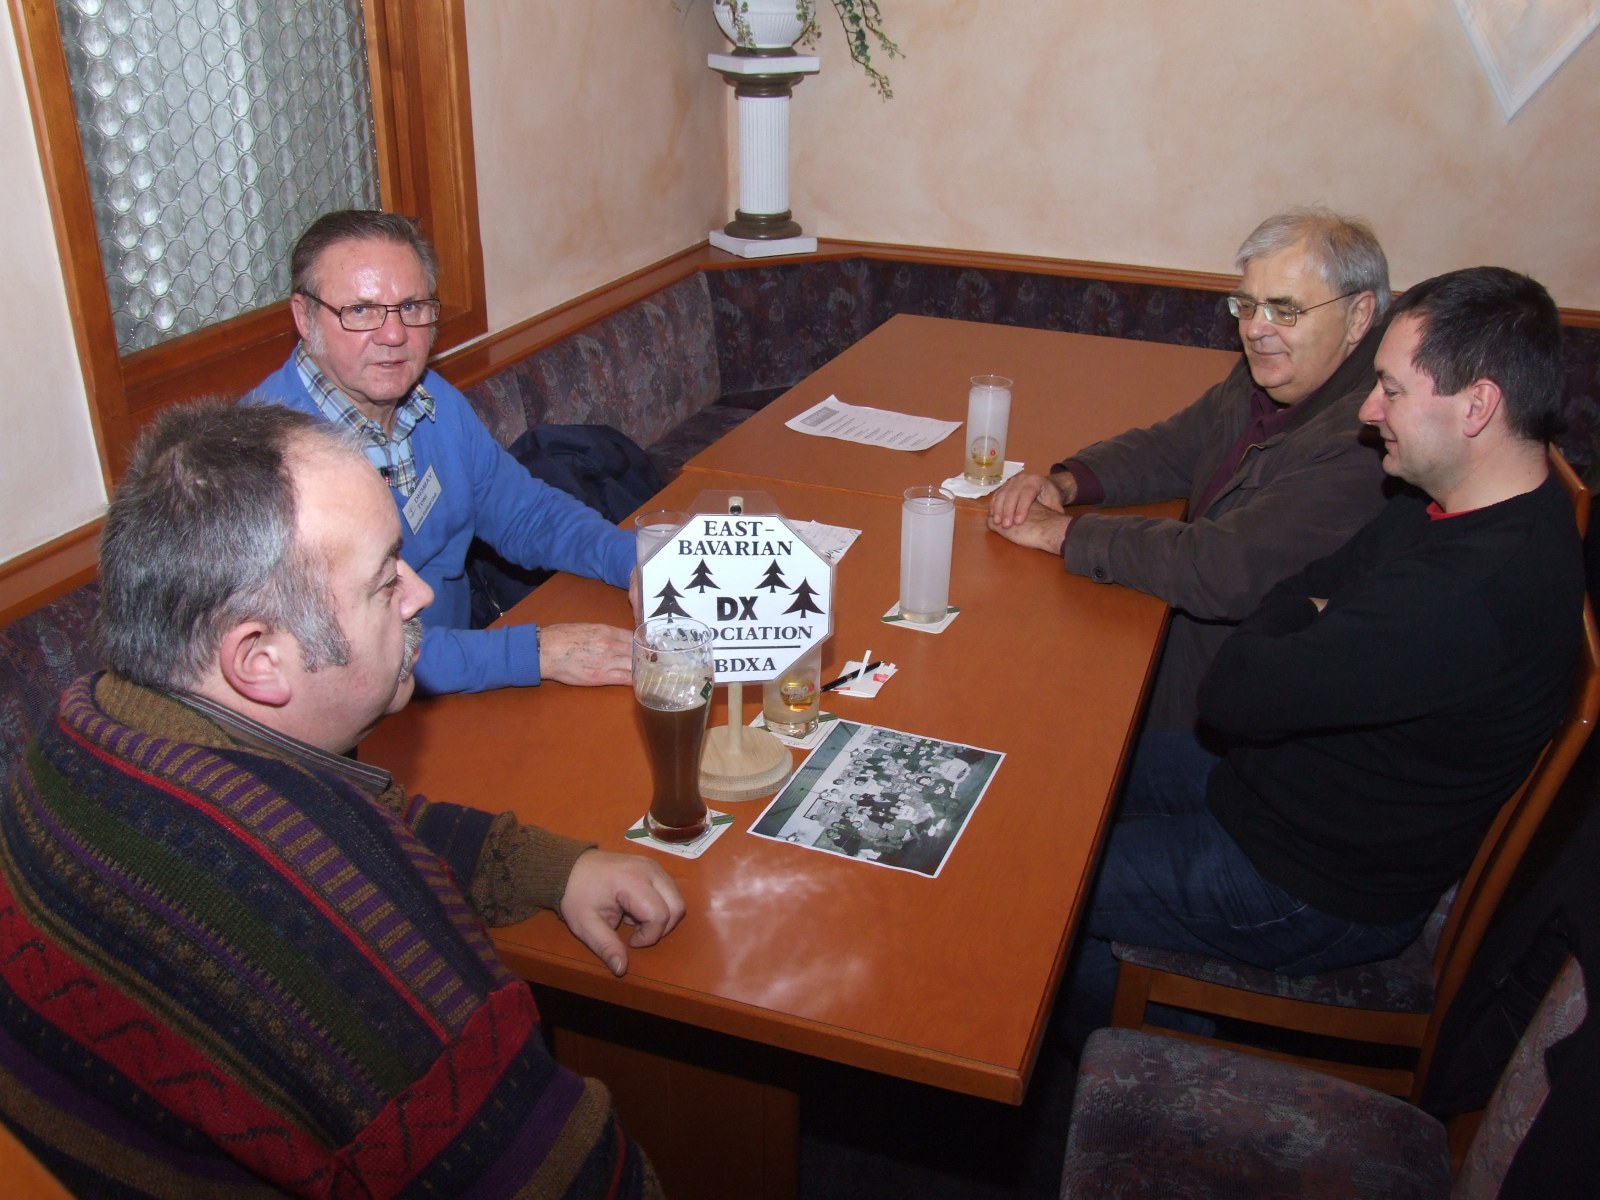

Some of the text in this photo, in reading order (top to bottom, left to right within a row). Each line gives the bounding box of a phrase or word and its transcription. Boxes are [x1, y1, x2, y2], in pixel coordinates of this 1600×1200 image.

[704, 520, 775, 537] EAST-
[678, 539, 793, 556] BAVARIAN
[716, 595, 759, 622] DX
[672, 625, 814, 642] OCIATION
[705, 656, 777, 673] BDXA
